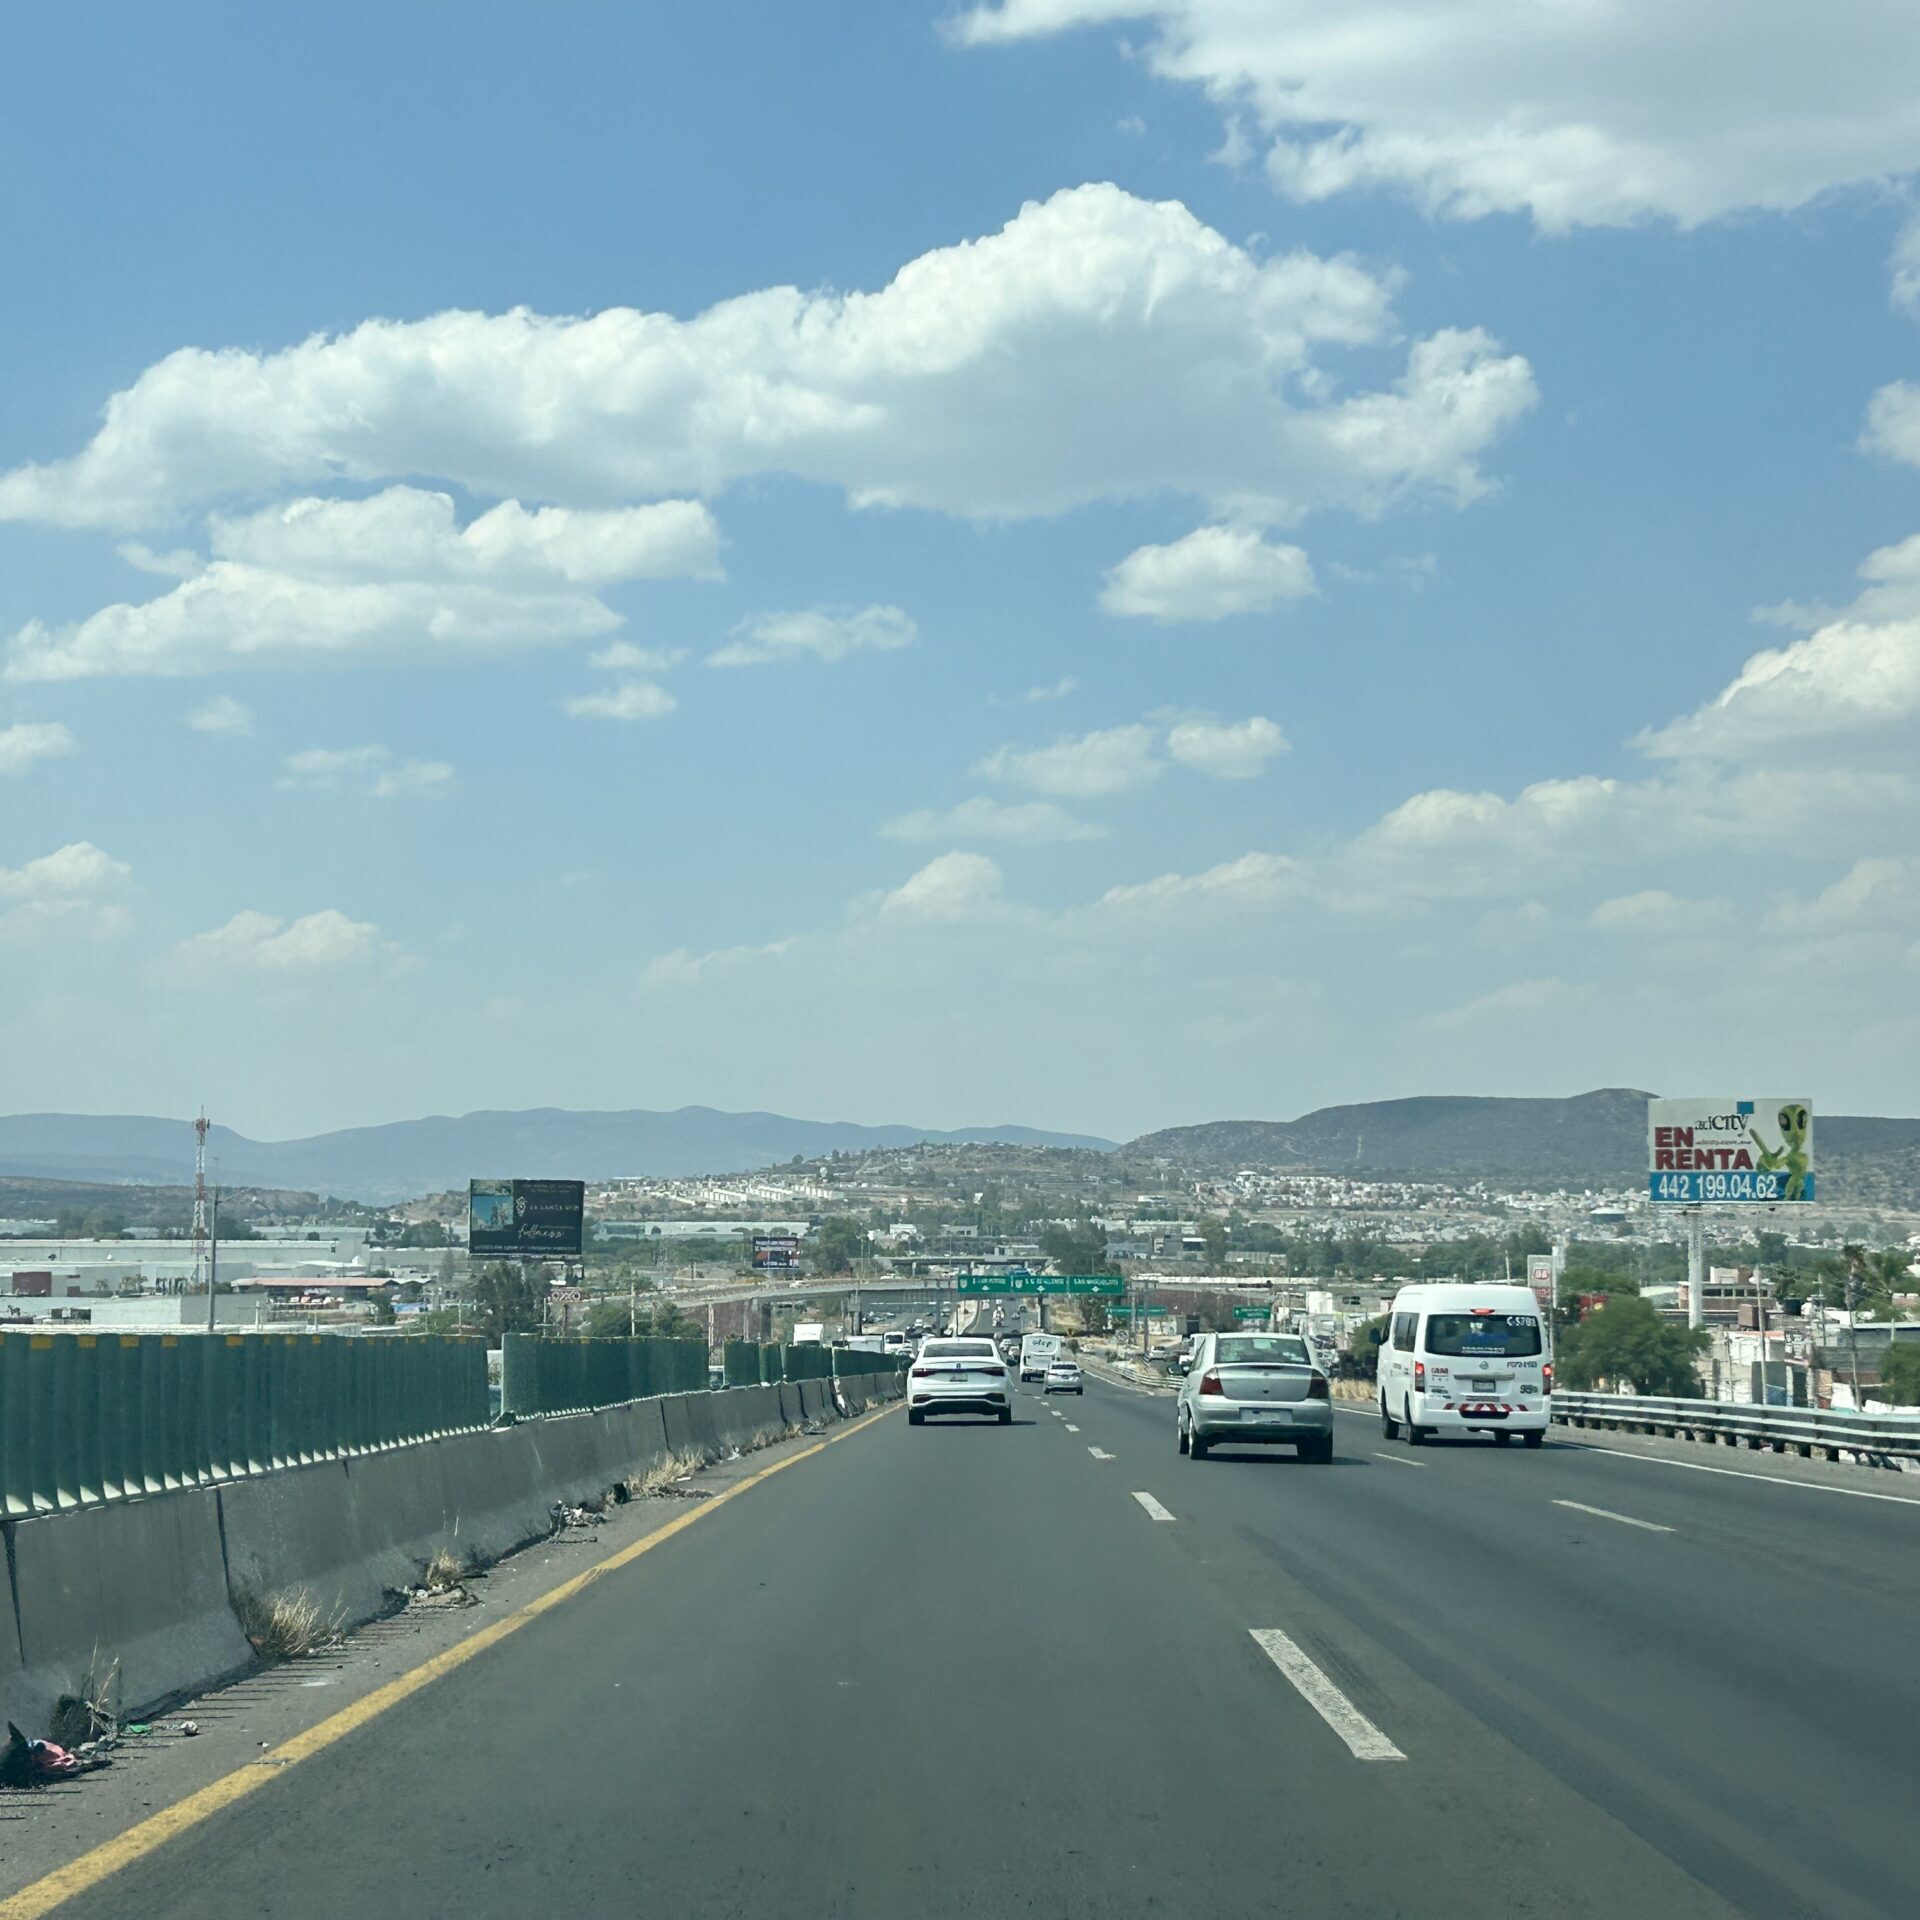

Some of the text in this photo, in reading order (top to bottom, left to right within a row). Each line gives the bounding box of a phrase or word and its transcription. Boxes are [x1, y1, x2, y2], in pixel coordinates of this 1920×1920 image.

[1654, 1126, 1694, 1148] EN
[1654, 1149, 1754, 1170] RENTA
[1658, 1174, 1778, 1199] 442 199.04.62
